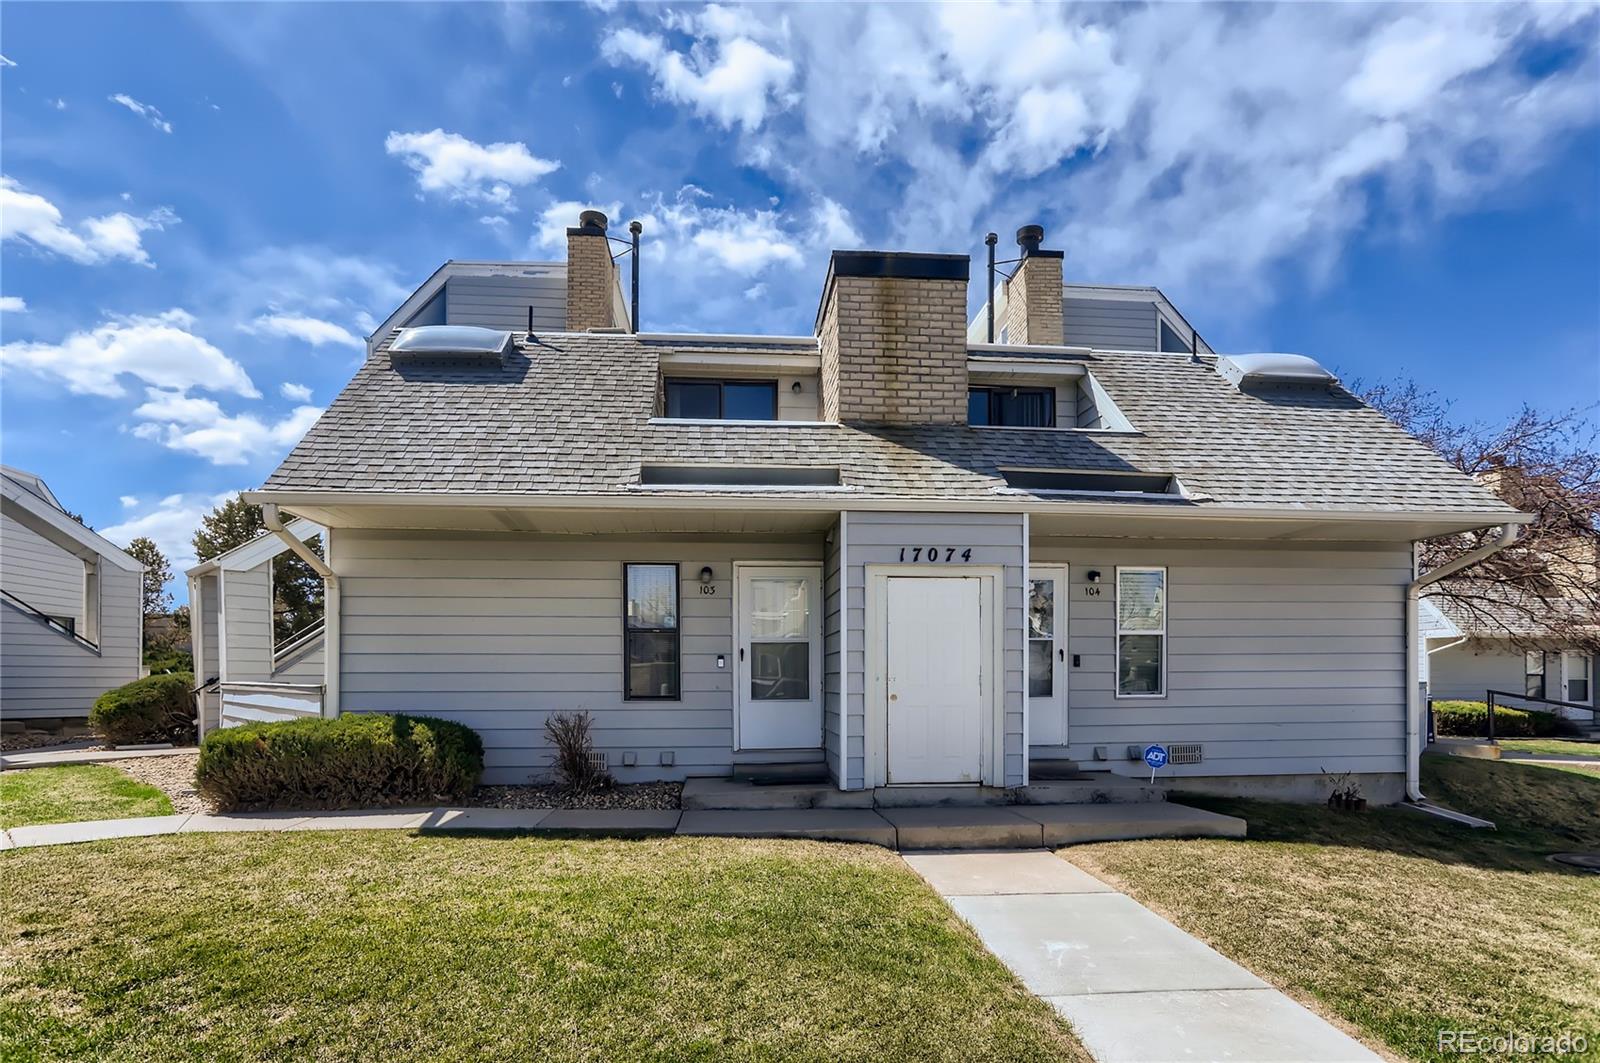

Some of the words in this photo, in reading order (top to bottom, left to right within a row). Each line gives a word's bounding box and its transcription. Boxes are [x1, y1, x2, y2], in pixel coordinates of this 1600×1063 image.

[900, 547, 972, 562] 17074
[699, 585, 715, 595] 103
[1085, 587, 1101, 596] 104
[1147, 751, 1166, 762] ADT
